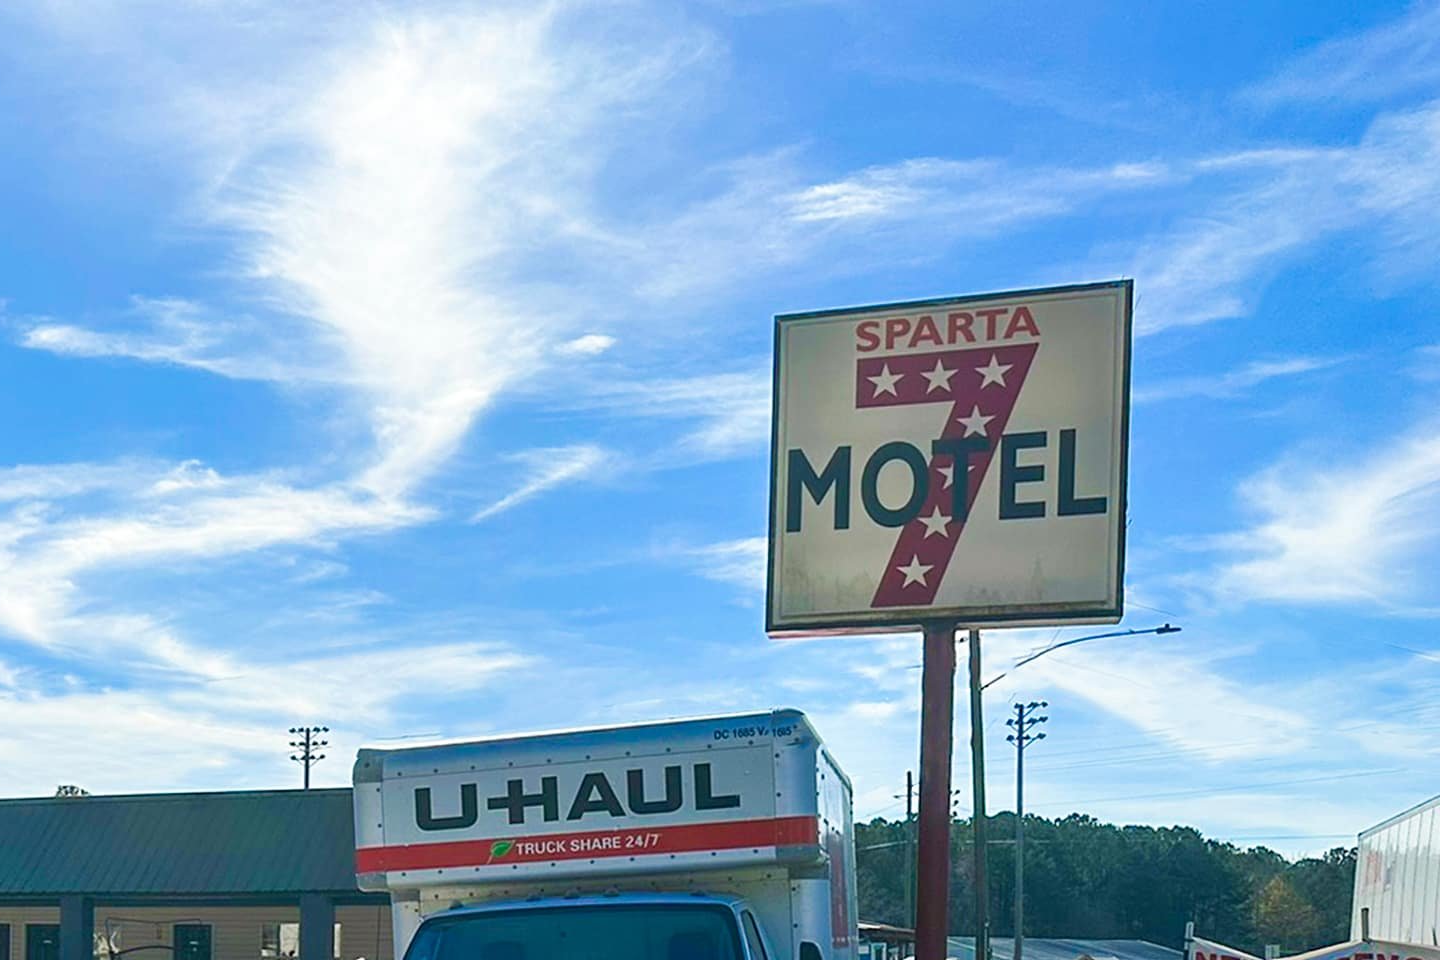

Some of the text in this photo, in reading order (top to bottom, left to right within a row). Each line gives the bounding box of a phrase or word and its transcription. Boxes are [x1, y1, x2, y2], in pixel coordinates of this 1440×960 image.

[855, 306, 1041, 353] SPARTA
[785, 428, 1108, 534] MOTEL
[855, 342, 1039, 608] 7
[713, 729, 729, 740] DC
[414, 762, 741, 831] U-HAUL
[516, 833, 659, 855] TRUCK SHARE 24/7
